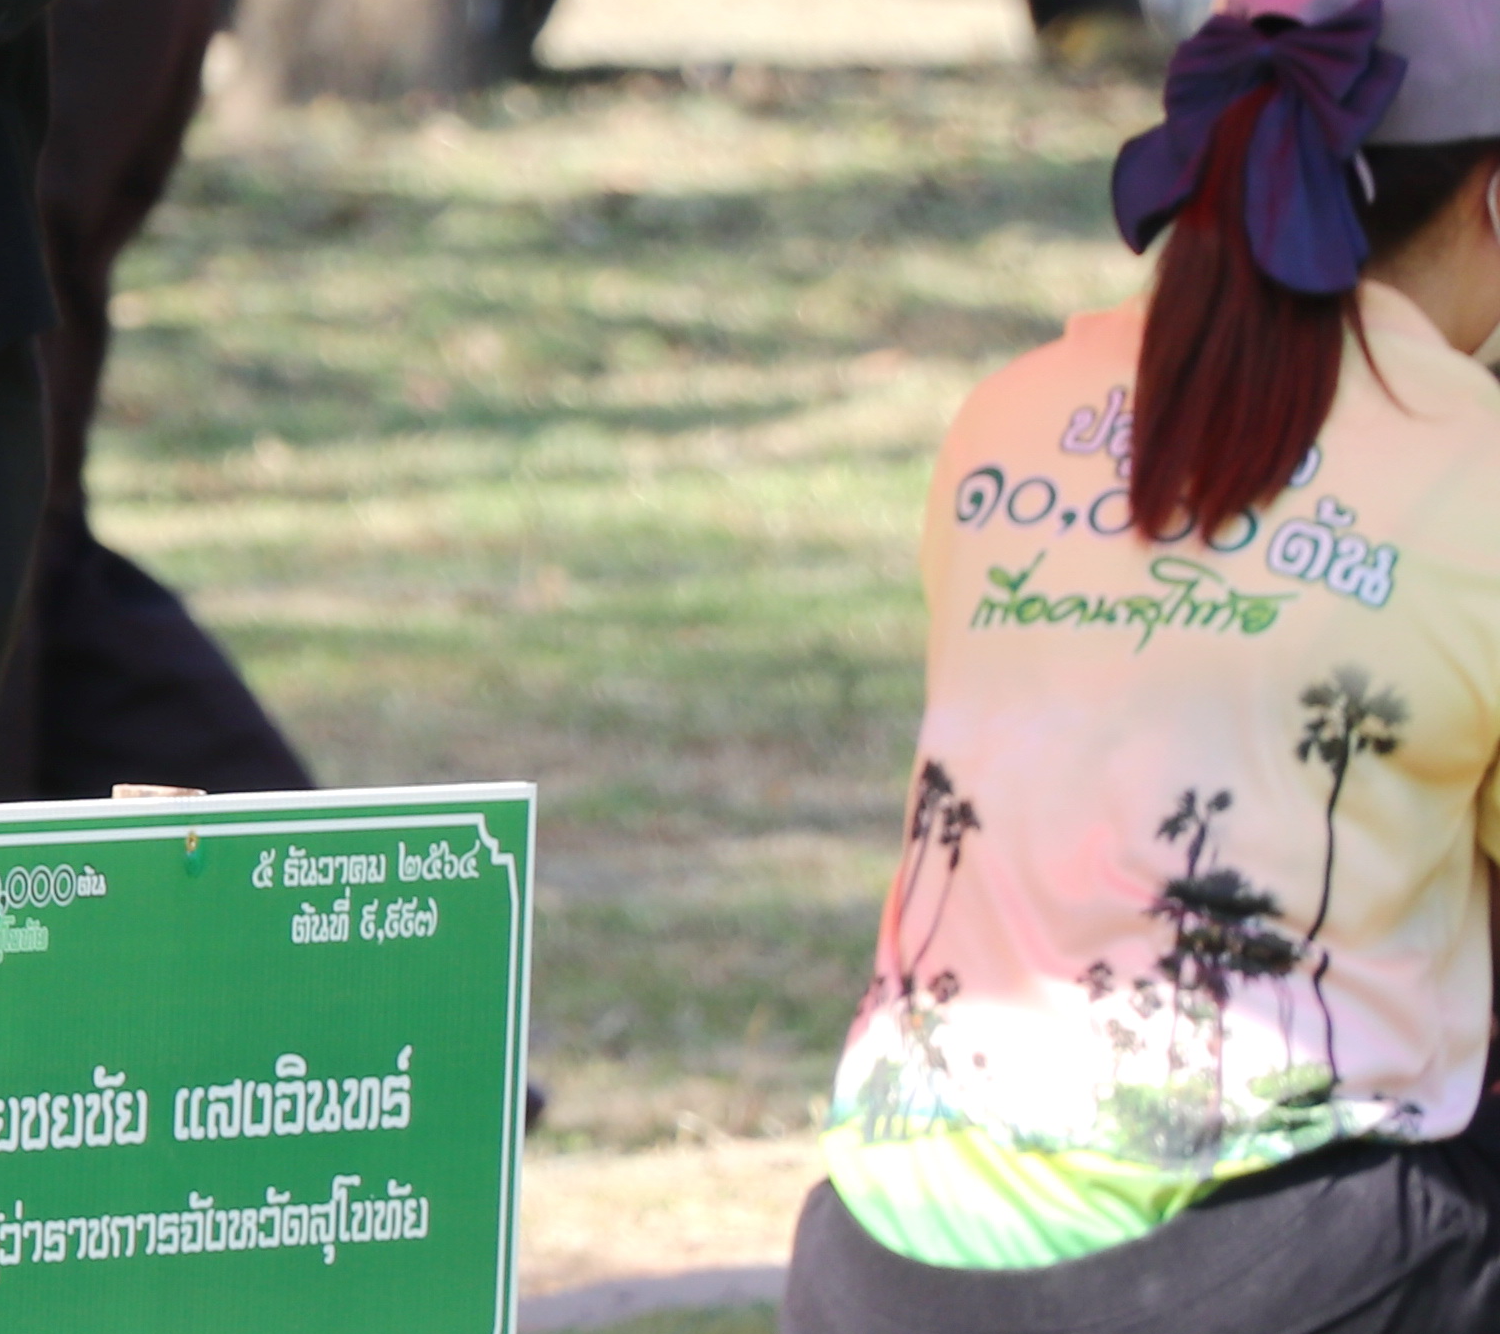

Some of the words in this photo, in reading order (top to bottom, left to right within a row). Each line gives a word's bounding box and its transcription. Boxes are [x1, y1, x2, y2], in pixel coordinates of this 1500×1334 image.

[1267, 496, 1398, 608] ต้น
[283, 845, 386, 887] ธันวาคม
[398, 839, 480, 882] ๒๕๖๔
[291, 886, 350, 944] ต้นที่
[173, 1044, 412, 1141] แสงอินทร์
